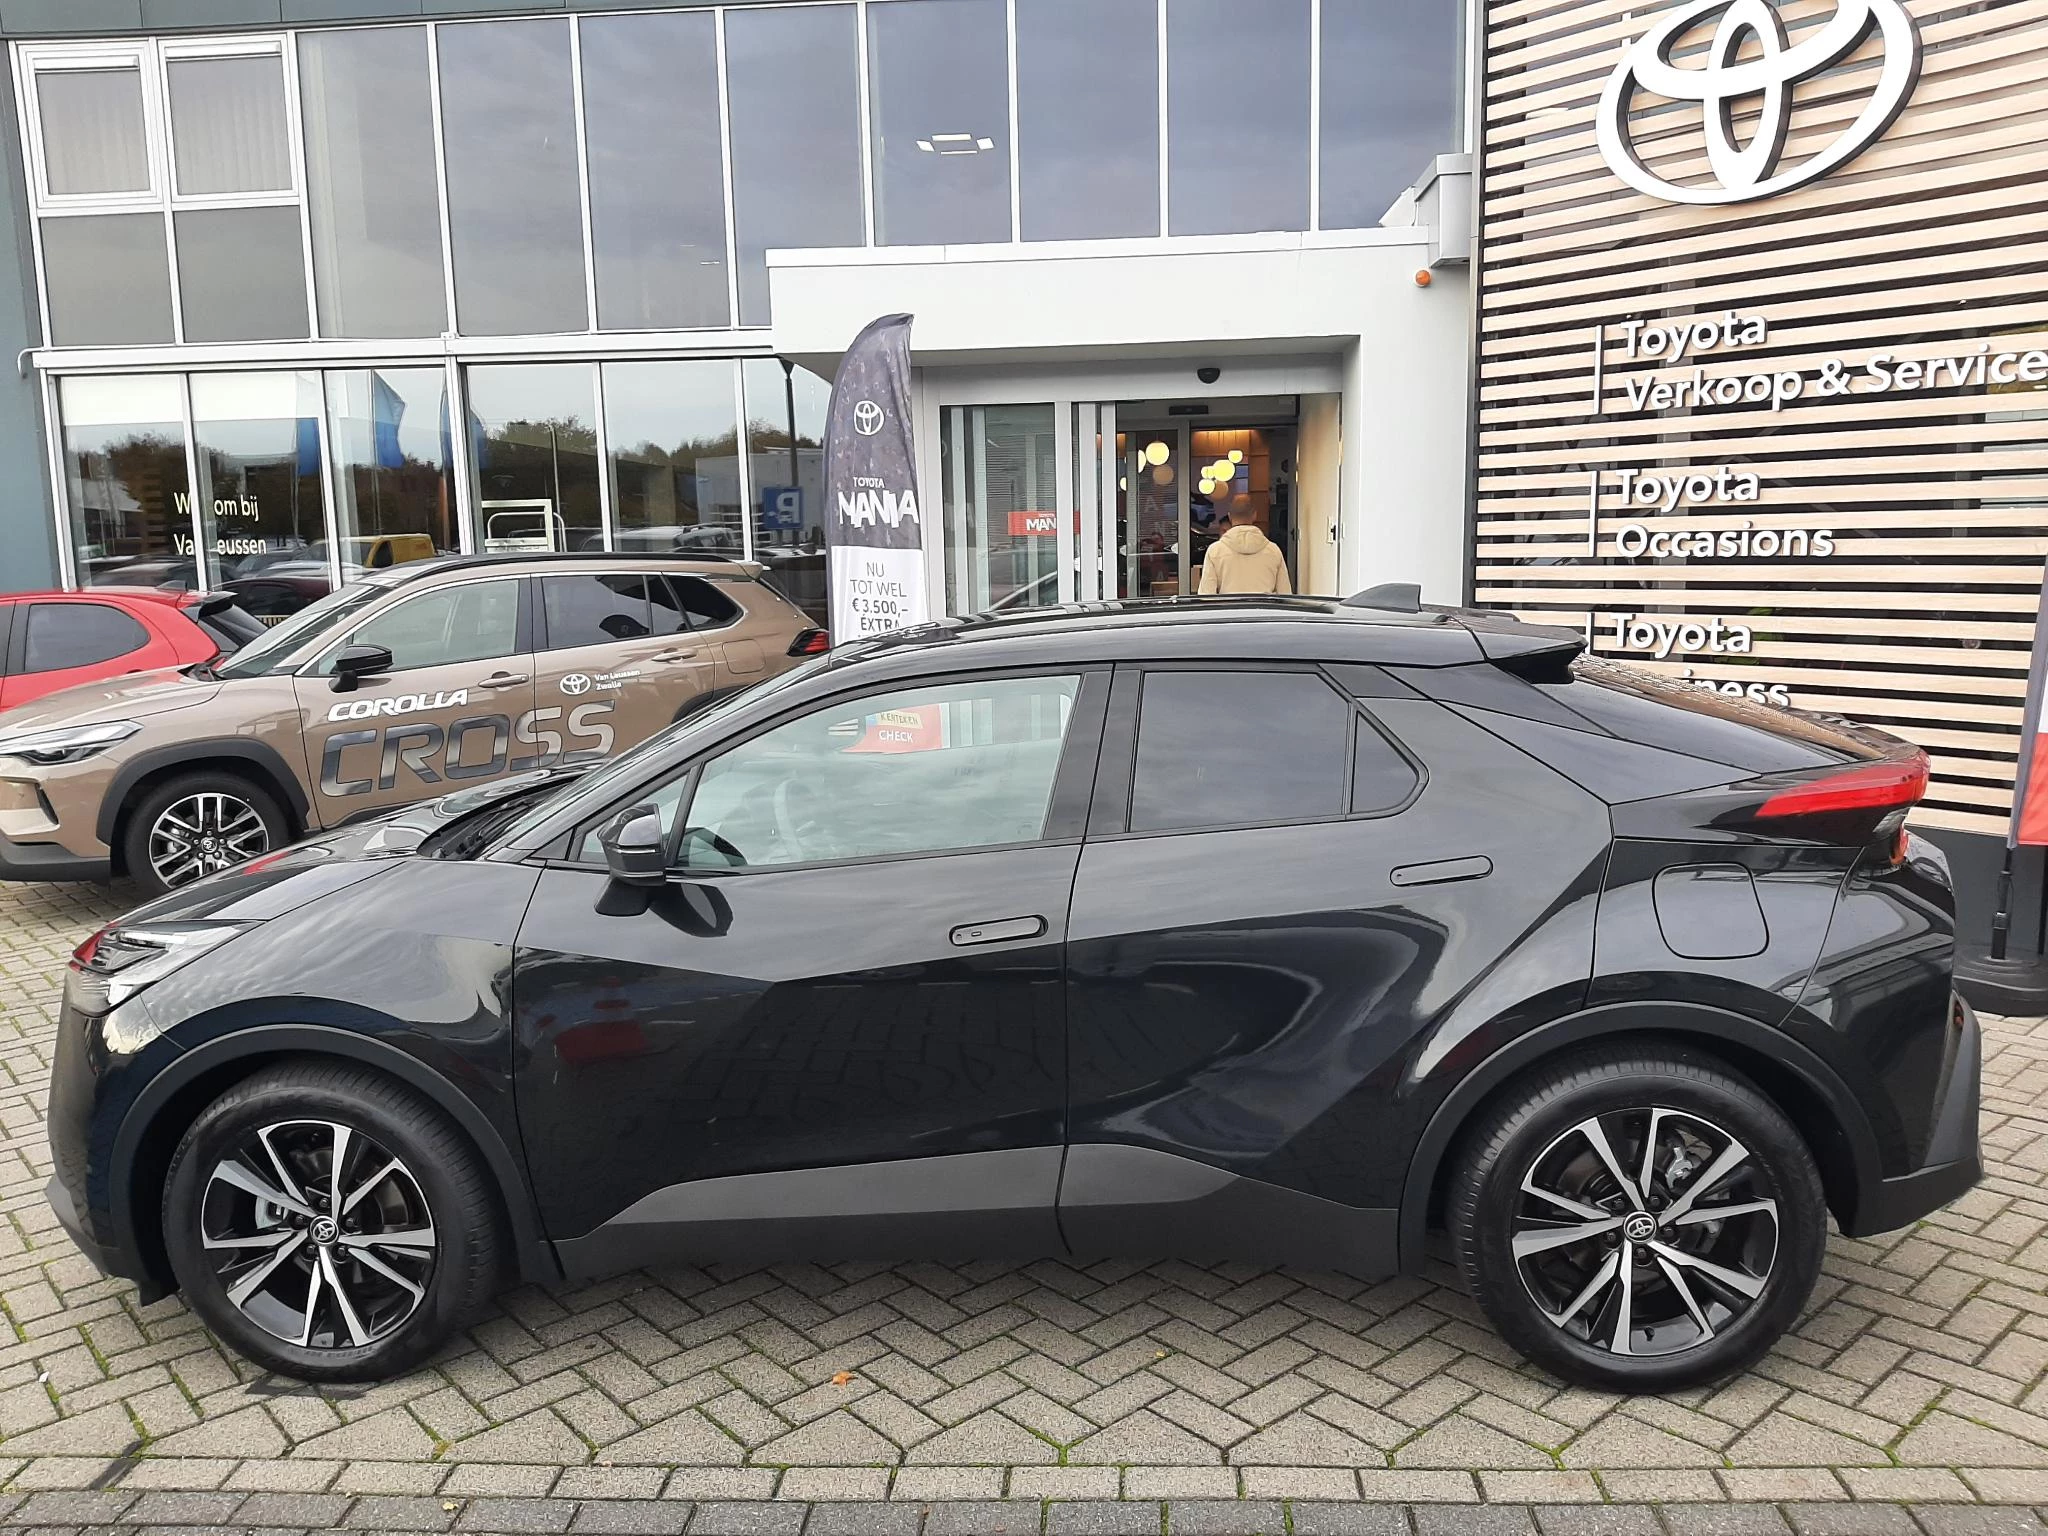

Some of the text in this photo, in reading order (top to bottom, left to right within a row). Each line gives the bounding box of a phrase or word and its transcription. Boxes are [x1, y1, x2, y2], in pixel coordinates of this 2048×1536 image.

[1620, 311, 1767, 363] Toyota
[1625, 342, 2048, 411] Verkoop & Service
[853, 476, 885, 489] TOYOTA
[1615, 466, 1760, 513] Toyota
[174, 492, 259, 522] Wom bij
[837, 489, 920, 529] MANIA
[1026, 517, 1057, 532] MAN
[1615, 520, 1836, 558] Occasions
[173, 533, 267, 556] Va eussen
[866, 561, 885, 578] NU
[850, 579, 908, 598] TOT WEL
[1610, 613, 1753, 659] Toyota
[327, 688, 469, 722] COROLLA
[880, 711, 919, 726] KENTEKEN
[319, 699, 616, 798] CROSS
[878, 729, 914, 744] CHECK
